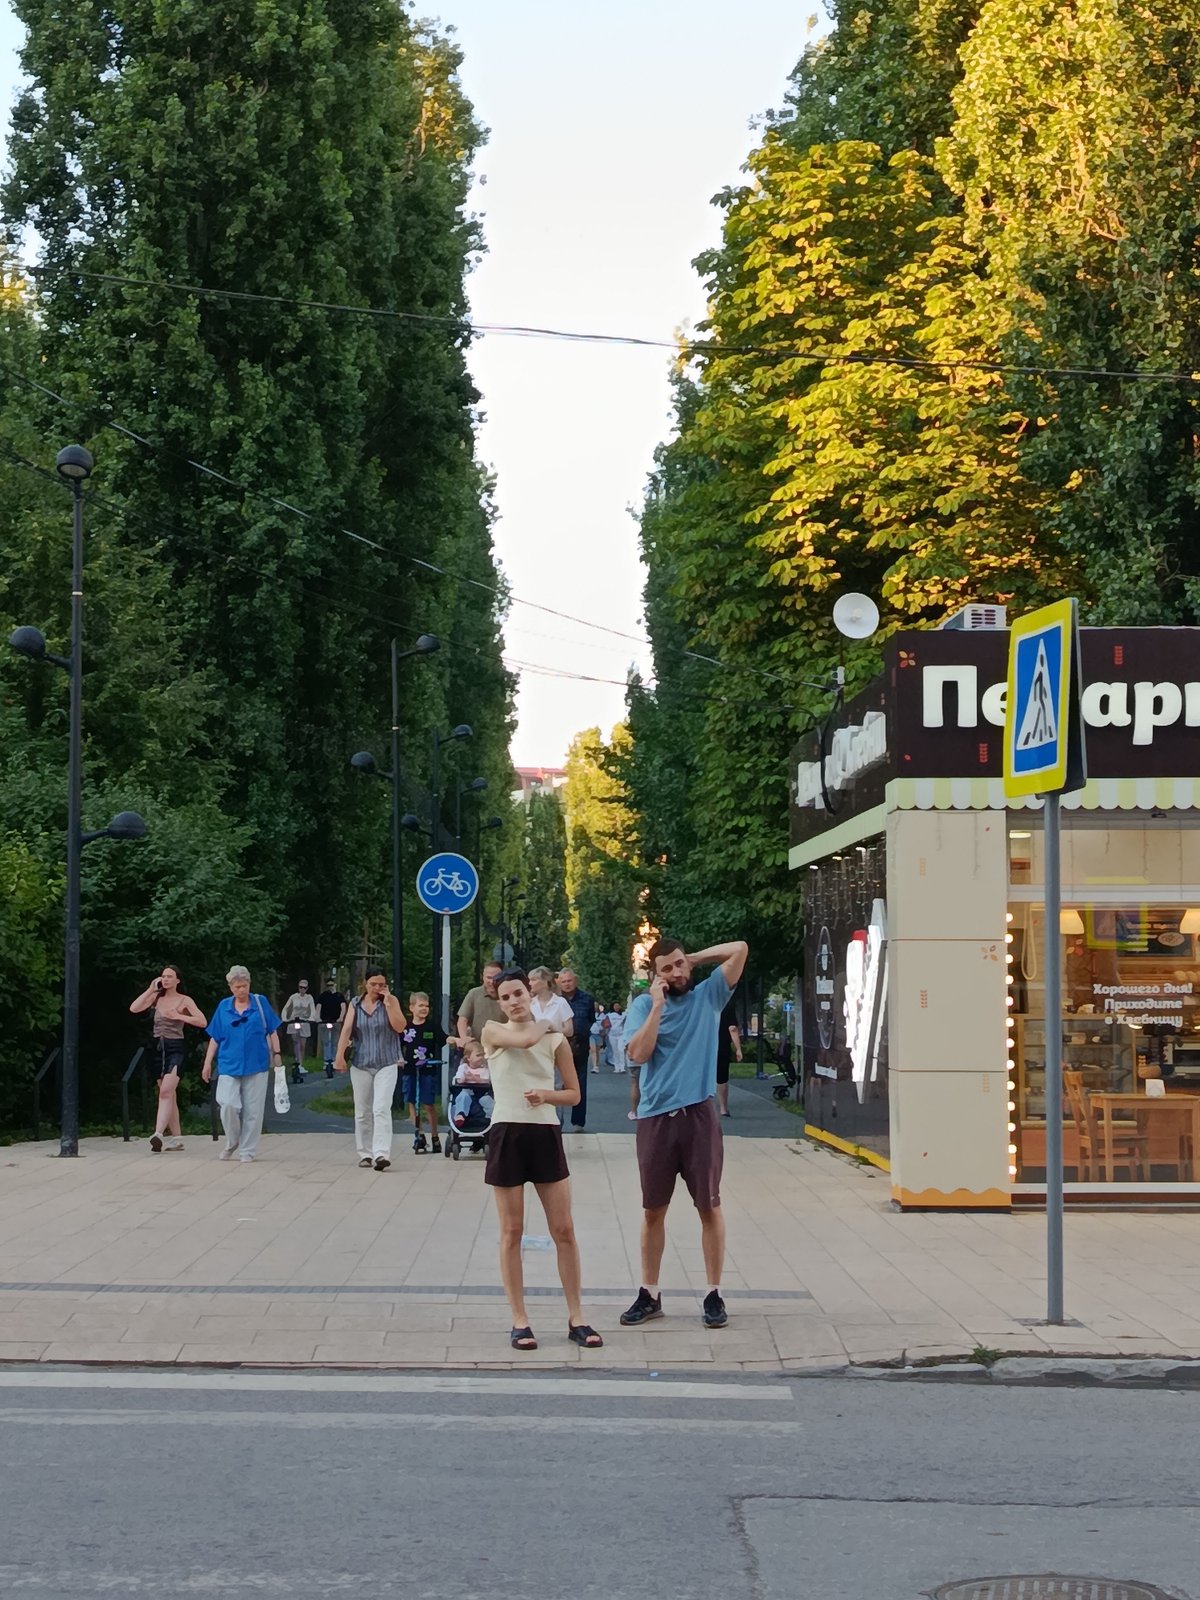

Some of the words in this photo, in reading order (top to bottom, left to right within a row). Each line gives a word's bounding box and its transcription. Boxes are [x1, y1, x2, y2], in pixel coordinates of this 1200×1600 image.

[922, 665, 1200, 745] Пеар
[1093, 984, 1160, 996] Хорошего
[1164, 983, 1193, 993] дня!
[1104, 998, 1182, 1011] Приходите
[1104, 1016, 1113, 1025] в
[1116, 1014, 1183, 1027] Хлебницу
